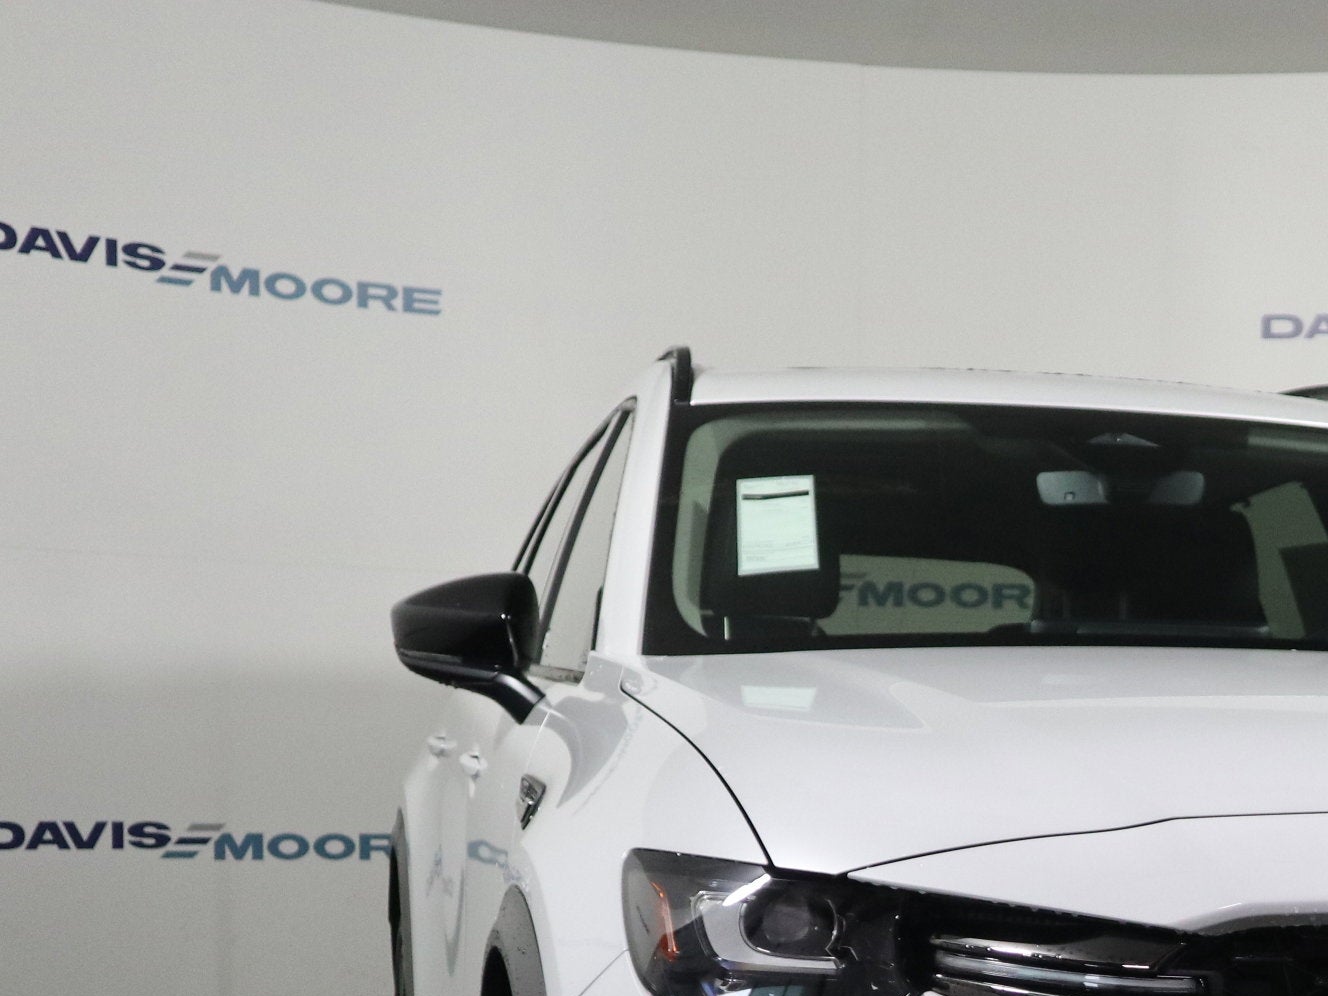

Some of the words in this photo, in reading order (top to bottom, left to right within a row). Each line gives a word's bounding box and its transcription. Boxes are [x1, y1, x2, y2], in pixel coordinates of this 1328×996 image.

[210, 265, 442, 316] MOORE
[857, 580, 1031, 609] MOOR
[213, 833, 392, 860] MOOR
